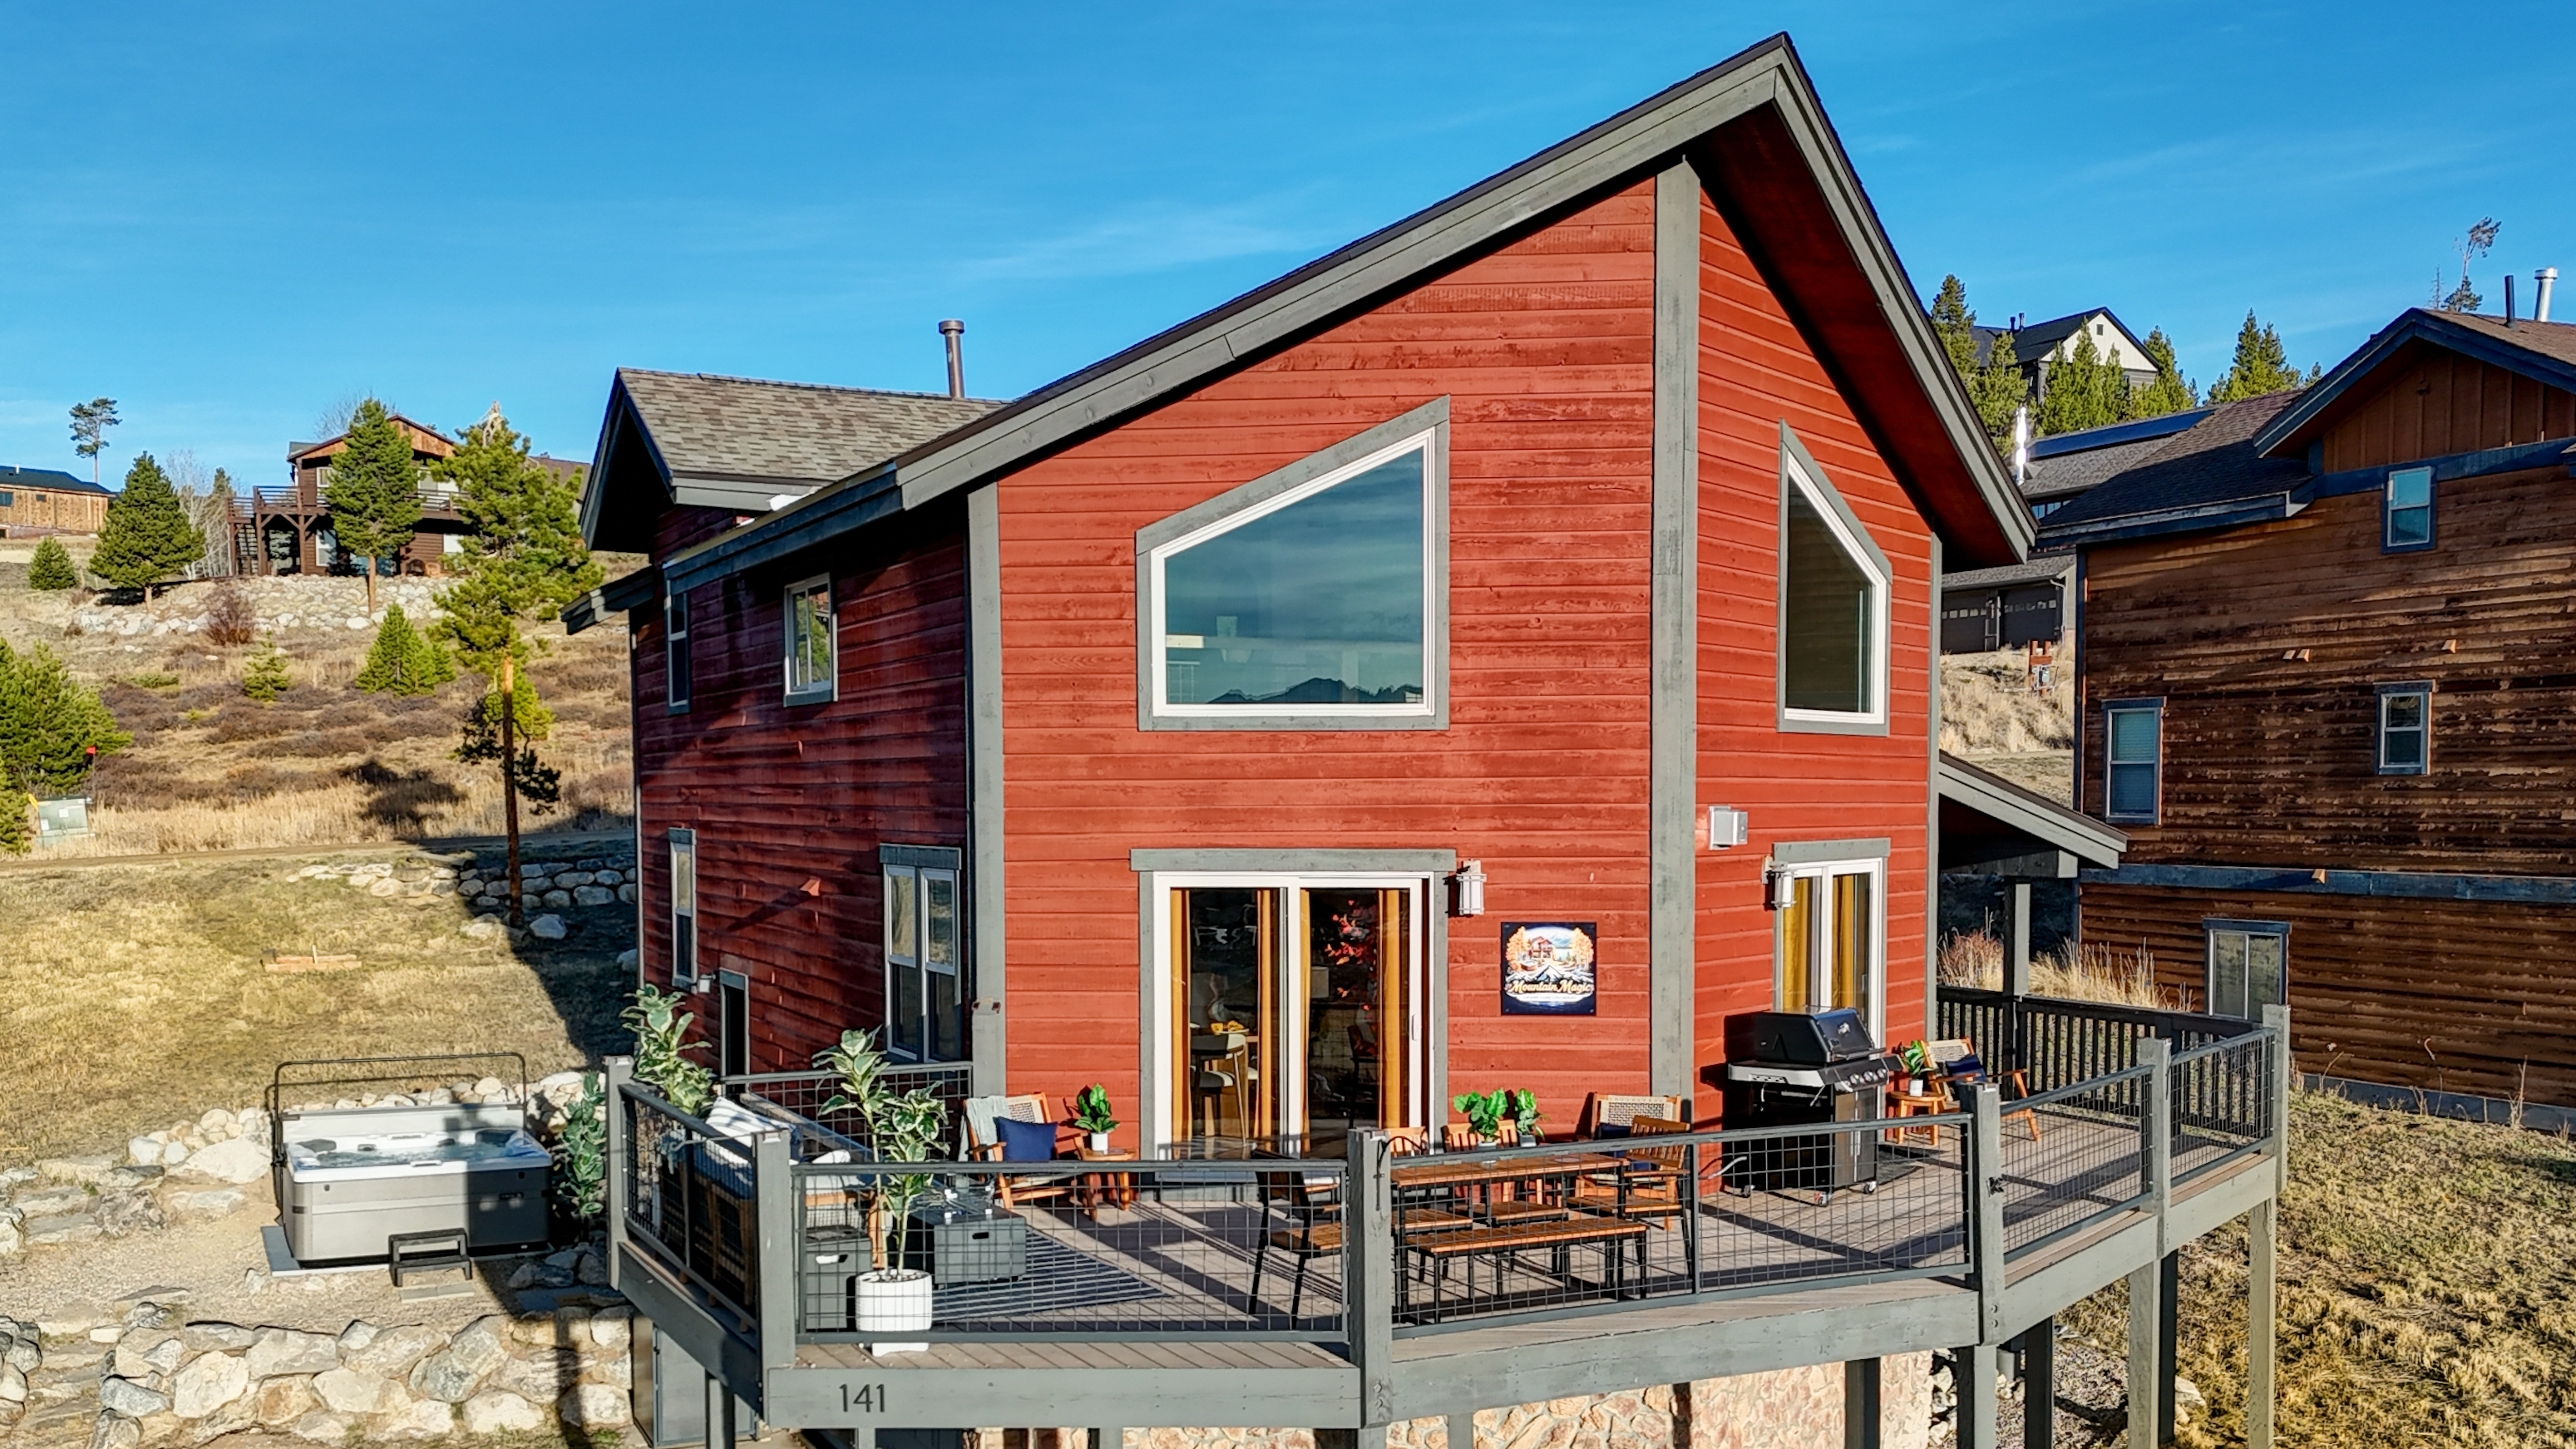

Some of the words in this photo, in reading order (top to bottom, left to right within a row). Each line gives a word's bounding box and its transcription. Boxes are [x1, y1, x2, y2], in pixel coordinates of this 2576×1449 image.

[1509, 979, 1557, 993] Mountain
[1557, 978, 1591, 994] Magic
[839, 1383, 885, 1412] 141
